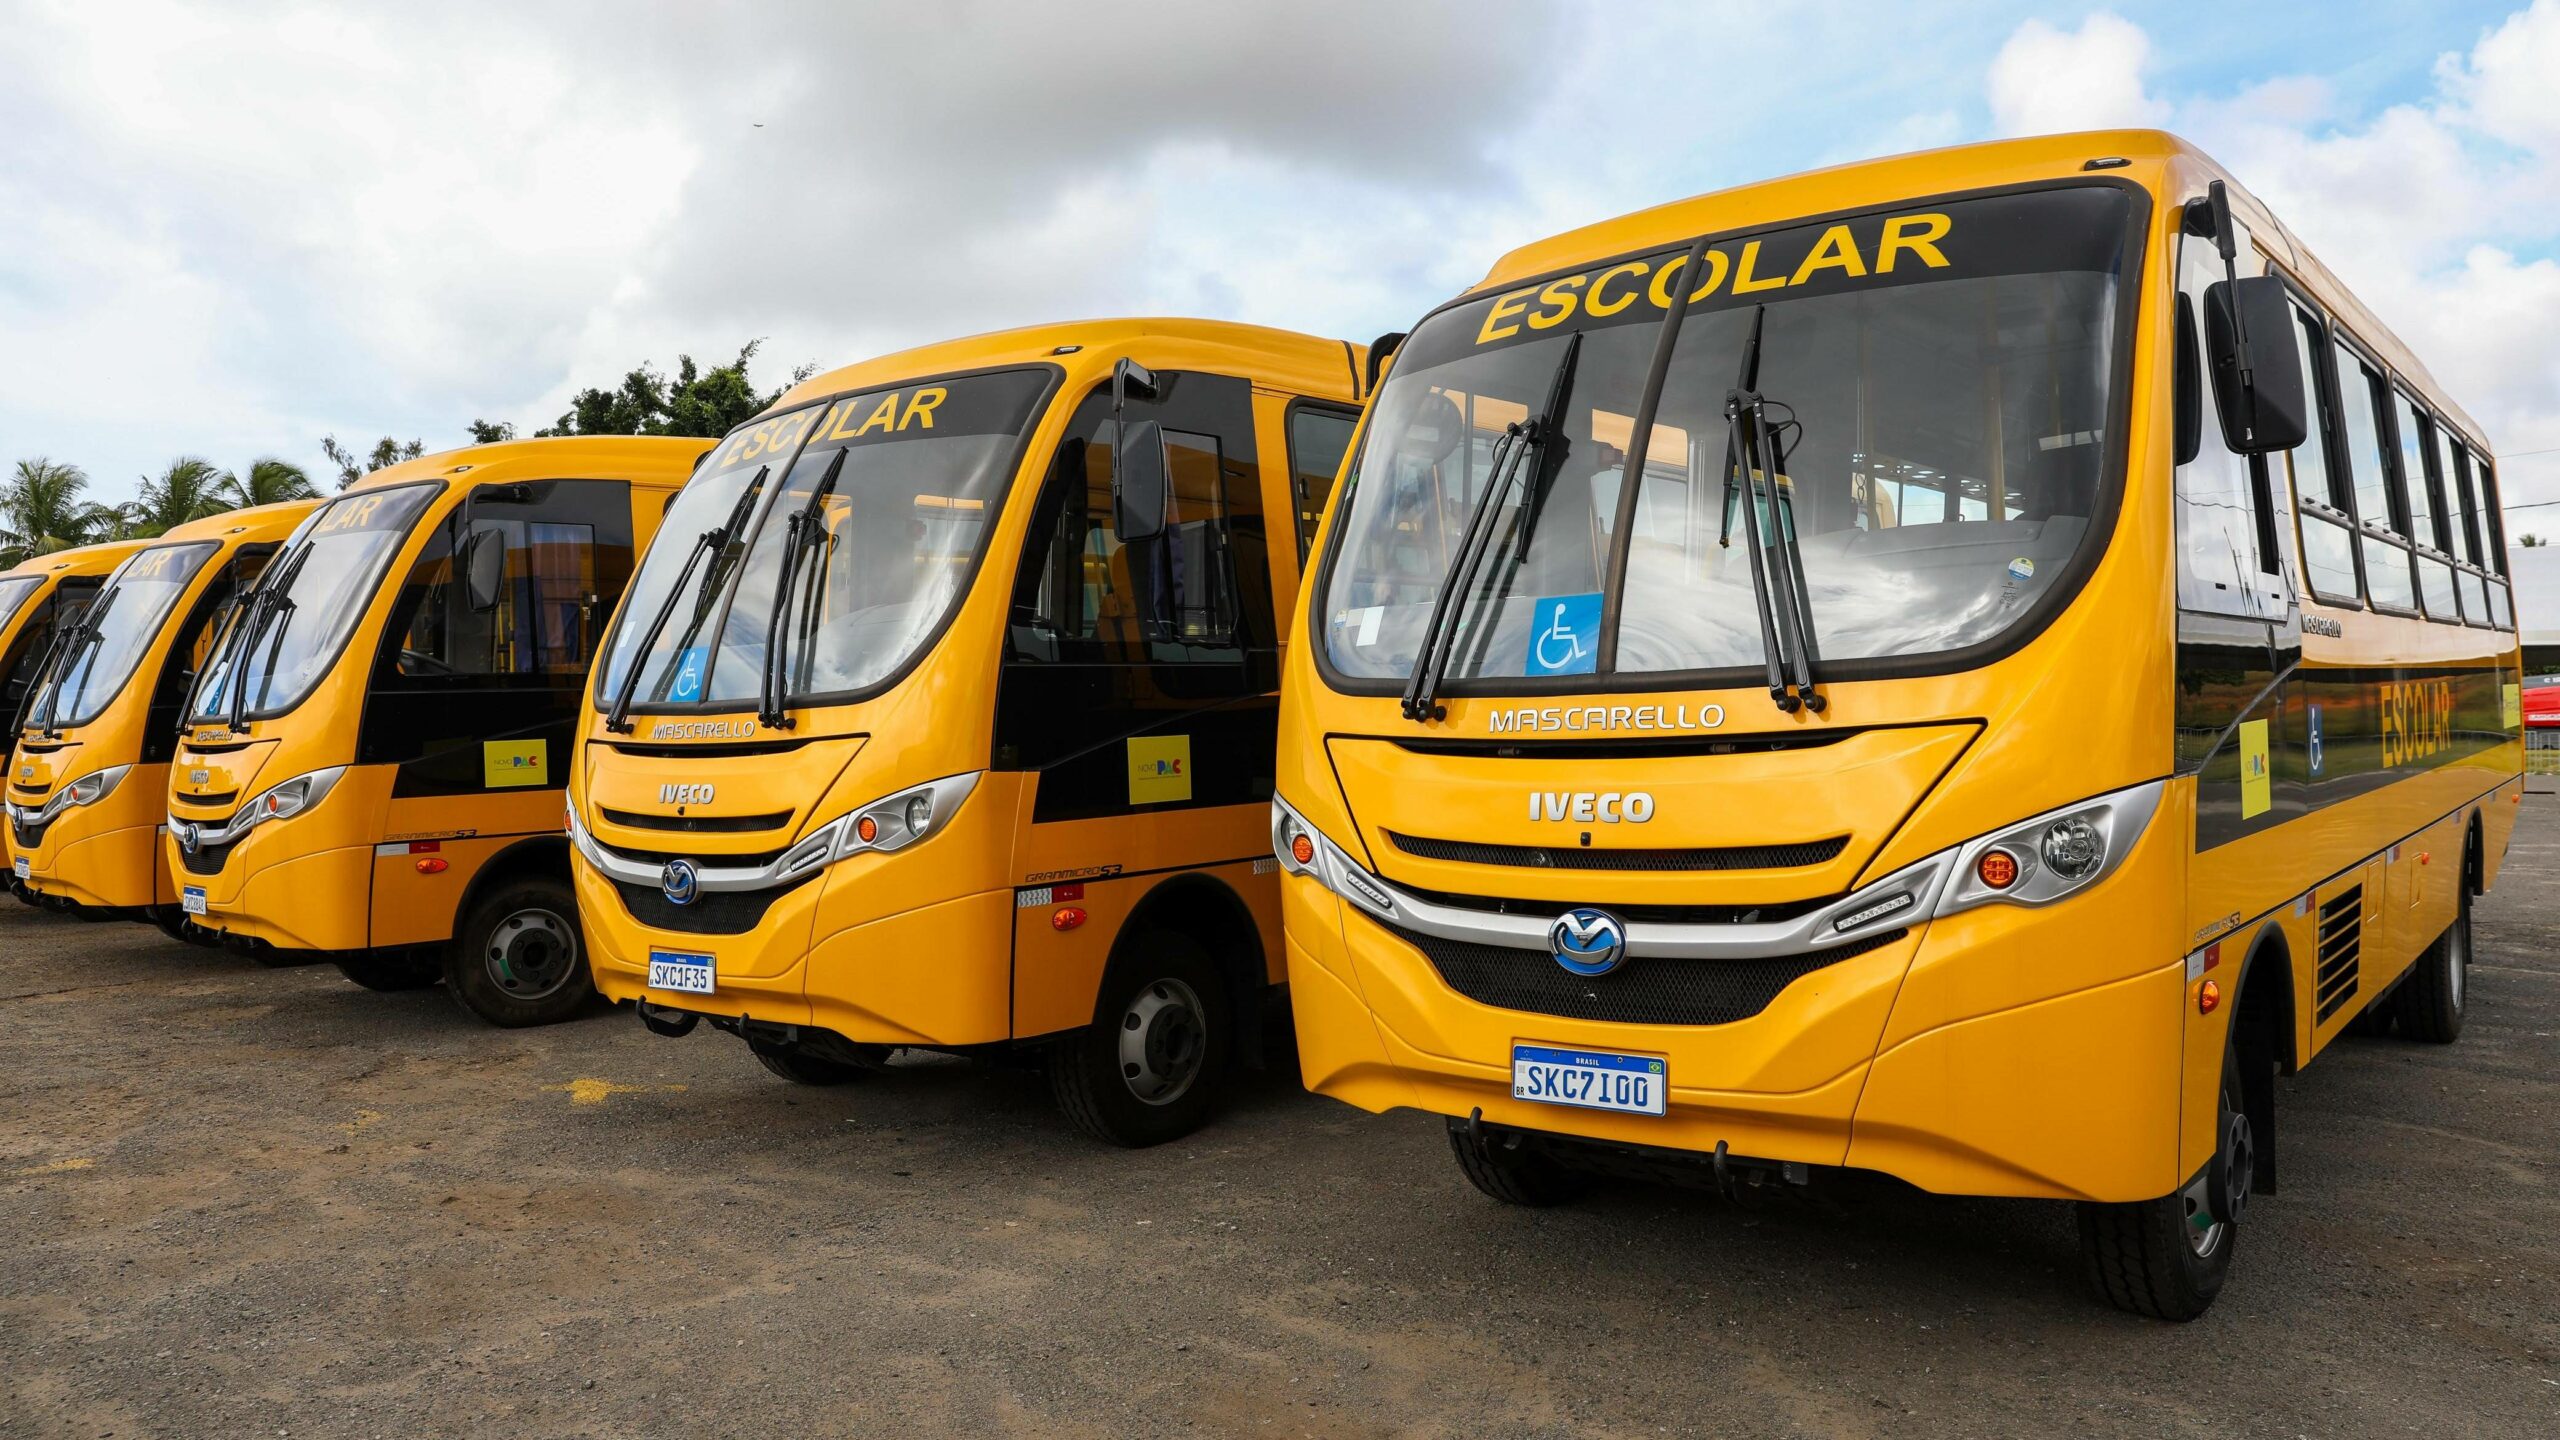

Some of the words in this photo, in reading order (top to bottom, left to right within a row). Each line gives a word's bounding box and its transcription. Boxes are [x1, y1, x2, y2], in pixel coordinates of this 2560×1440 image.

[1475, 213, 1952, 345] ESCOLAR
[1489, 704, 1726, 733] MASCARELLO
[2381, 682, 2451, 769] ESCOLAR
[652, 721, 755, 739] MASCARELLO
[513, 755, 537, 768] PAC
[1157, 758, 1182, 776] PAC
[659, 784, 715, 804] IVECO
[1529, 792, 1655, 823] IVECO
[654, 965, 707, 989] SKC1F35
[1575, 1057, 1600, 1067] BRASIL
[1516, 1086, 1525, 1096] BR
